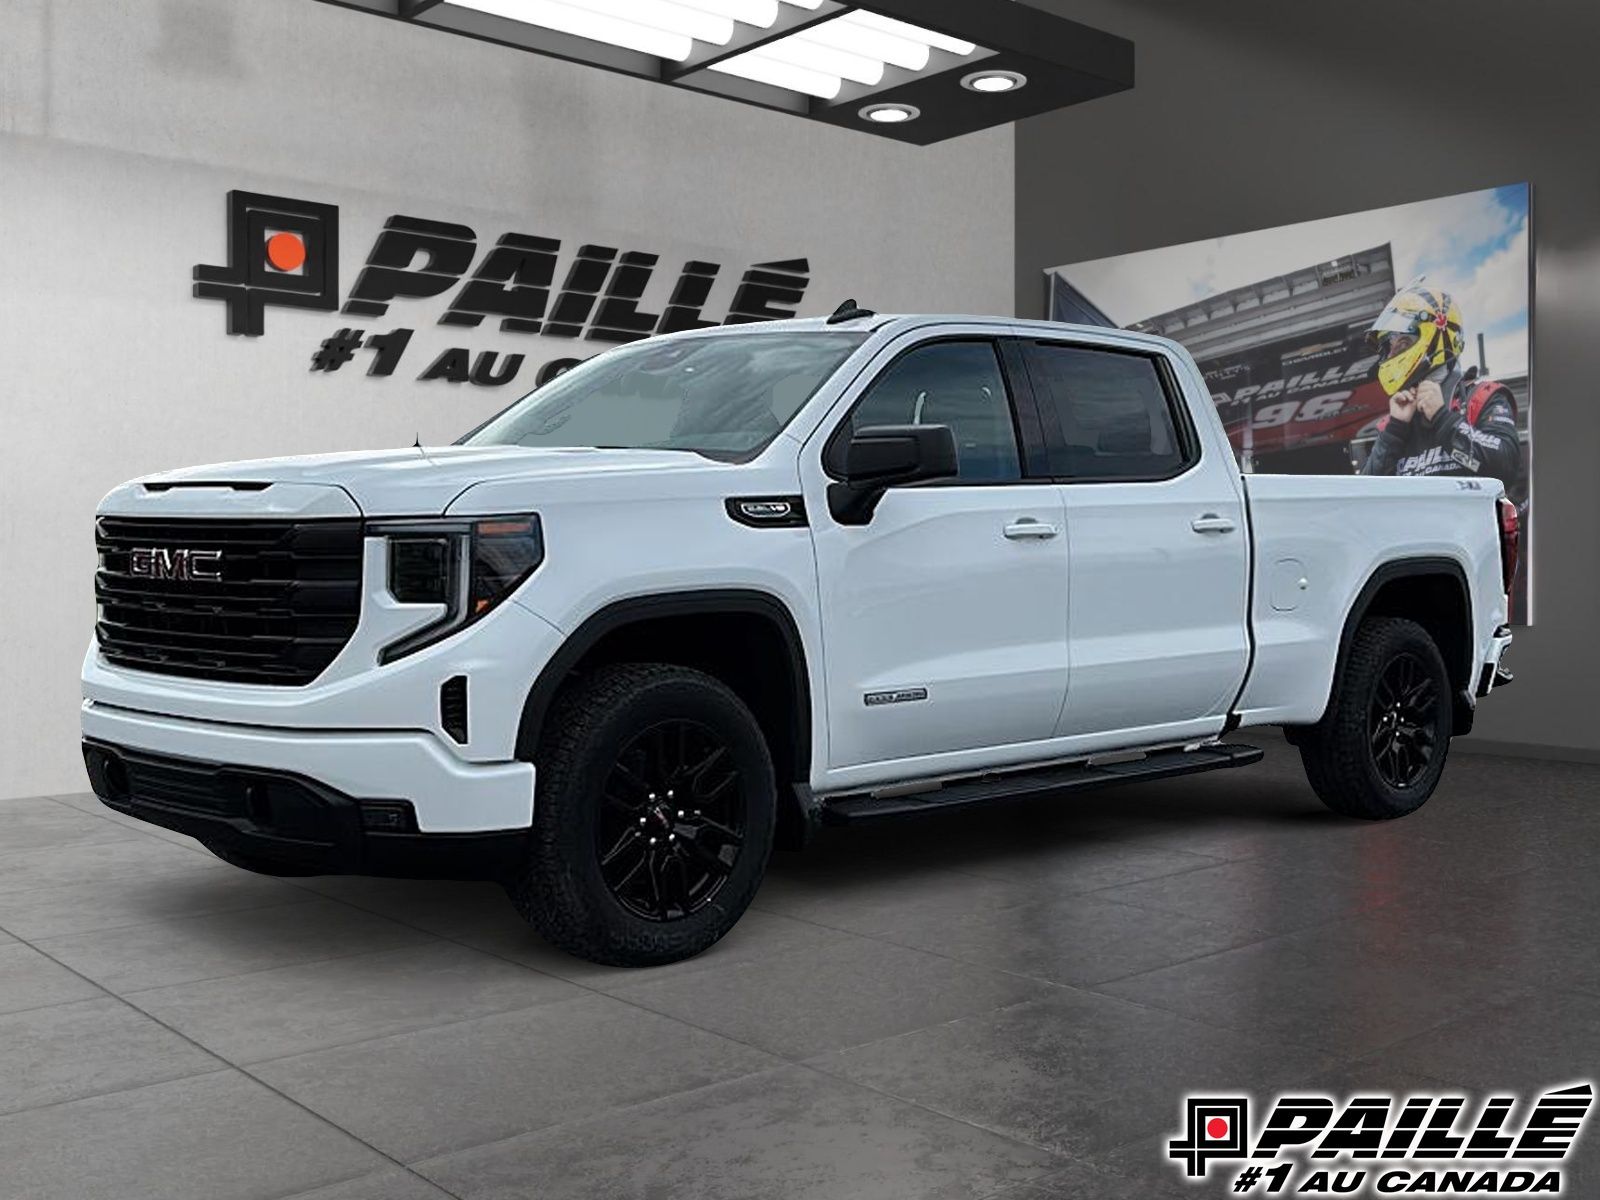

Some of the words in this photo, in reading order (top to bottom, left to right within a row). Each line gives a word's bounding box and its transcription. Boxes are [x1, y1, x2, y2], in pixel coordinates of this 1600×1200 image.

[340, 213, 810, 343] PAILLÉ
[310, 327, 414, 377] #1
[417, 348, 525, 386] AU
[1252, 390, 1353, 429] 96
[129, 547, 222, 582] GMC
